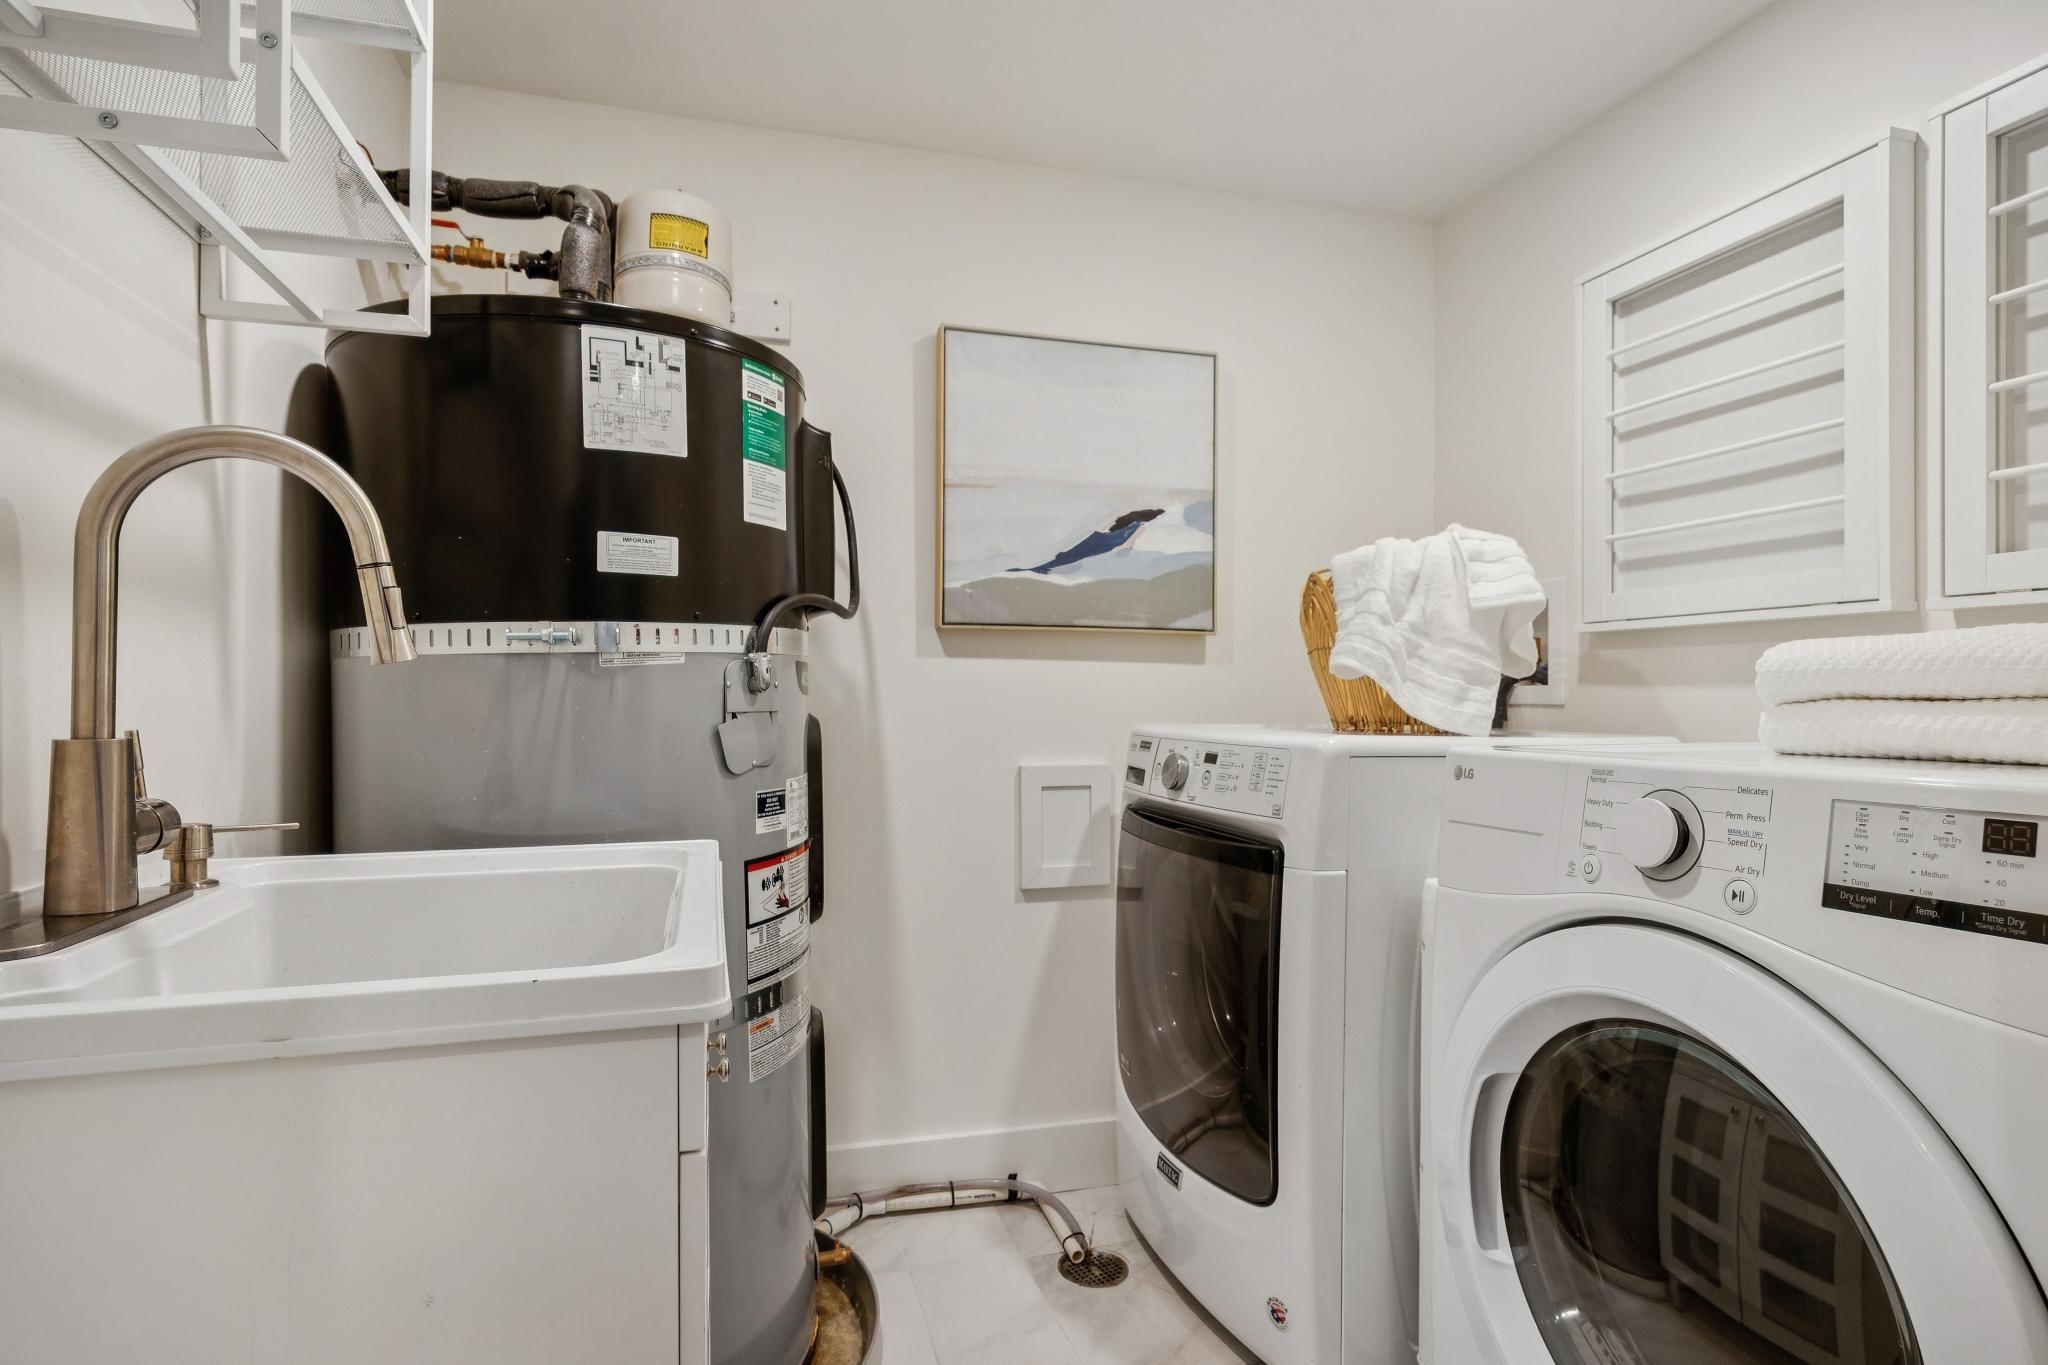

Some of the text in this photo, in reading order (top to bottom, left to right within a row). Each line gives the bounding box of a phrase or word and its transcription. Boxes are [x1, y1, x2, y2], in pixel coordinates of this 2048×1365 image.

[623, 537, 656, 545] IMPORTANT
[1737, 786, 1769, 796] Delicates
[1587, 798, 1615, 808] Heavy Duty
[1726, 811, 1766, 823] Perm. Press
[1942, 818, 1956, 826] Cool
[1584, 820, 1602, 830] Bedding
[1728, 828, 1764, 839] MANUAL DRY
[1727, 837, 1763, 851] Speed Dry
[1933, 834, 1962, 845] Damp Dry
[1582, 842, 1598, 851] Towels
[1854, 843, 1869, 852] Very
[1922, 851, 1939, 860] High
[1852, 861, 1876, 870] Normal
[1996, 860, 2025, 870] 60 min
[1735, 864, 1761, 877] Air Dry
[1920, 869, 1949, 880] Medium
[1851, 878, 1870, 887] Damp
[1995, 879, 2007, 887] 40
[1840, 890, 1877, 904] Dry Level
[1919, 888, 1934, 896] Low
[1994, 898, 2006, 907] 20
[1914, 905, 1940, 919] Temp.
[1980, 912, 2026, 929] Time Dry
[1995, 925, 2007, 934] Dry
[2008, 927, 2027, 936] Signal
[1158, 1157, 1180, 1184] MAYTAG
